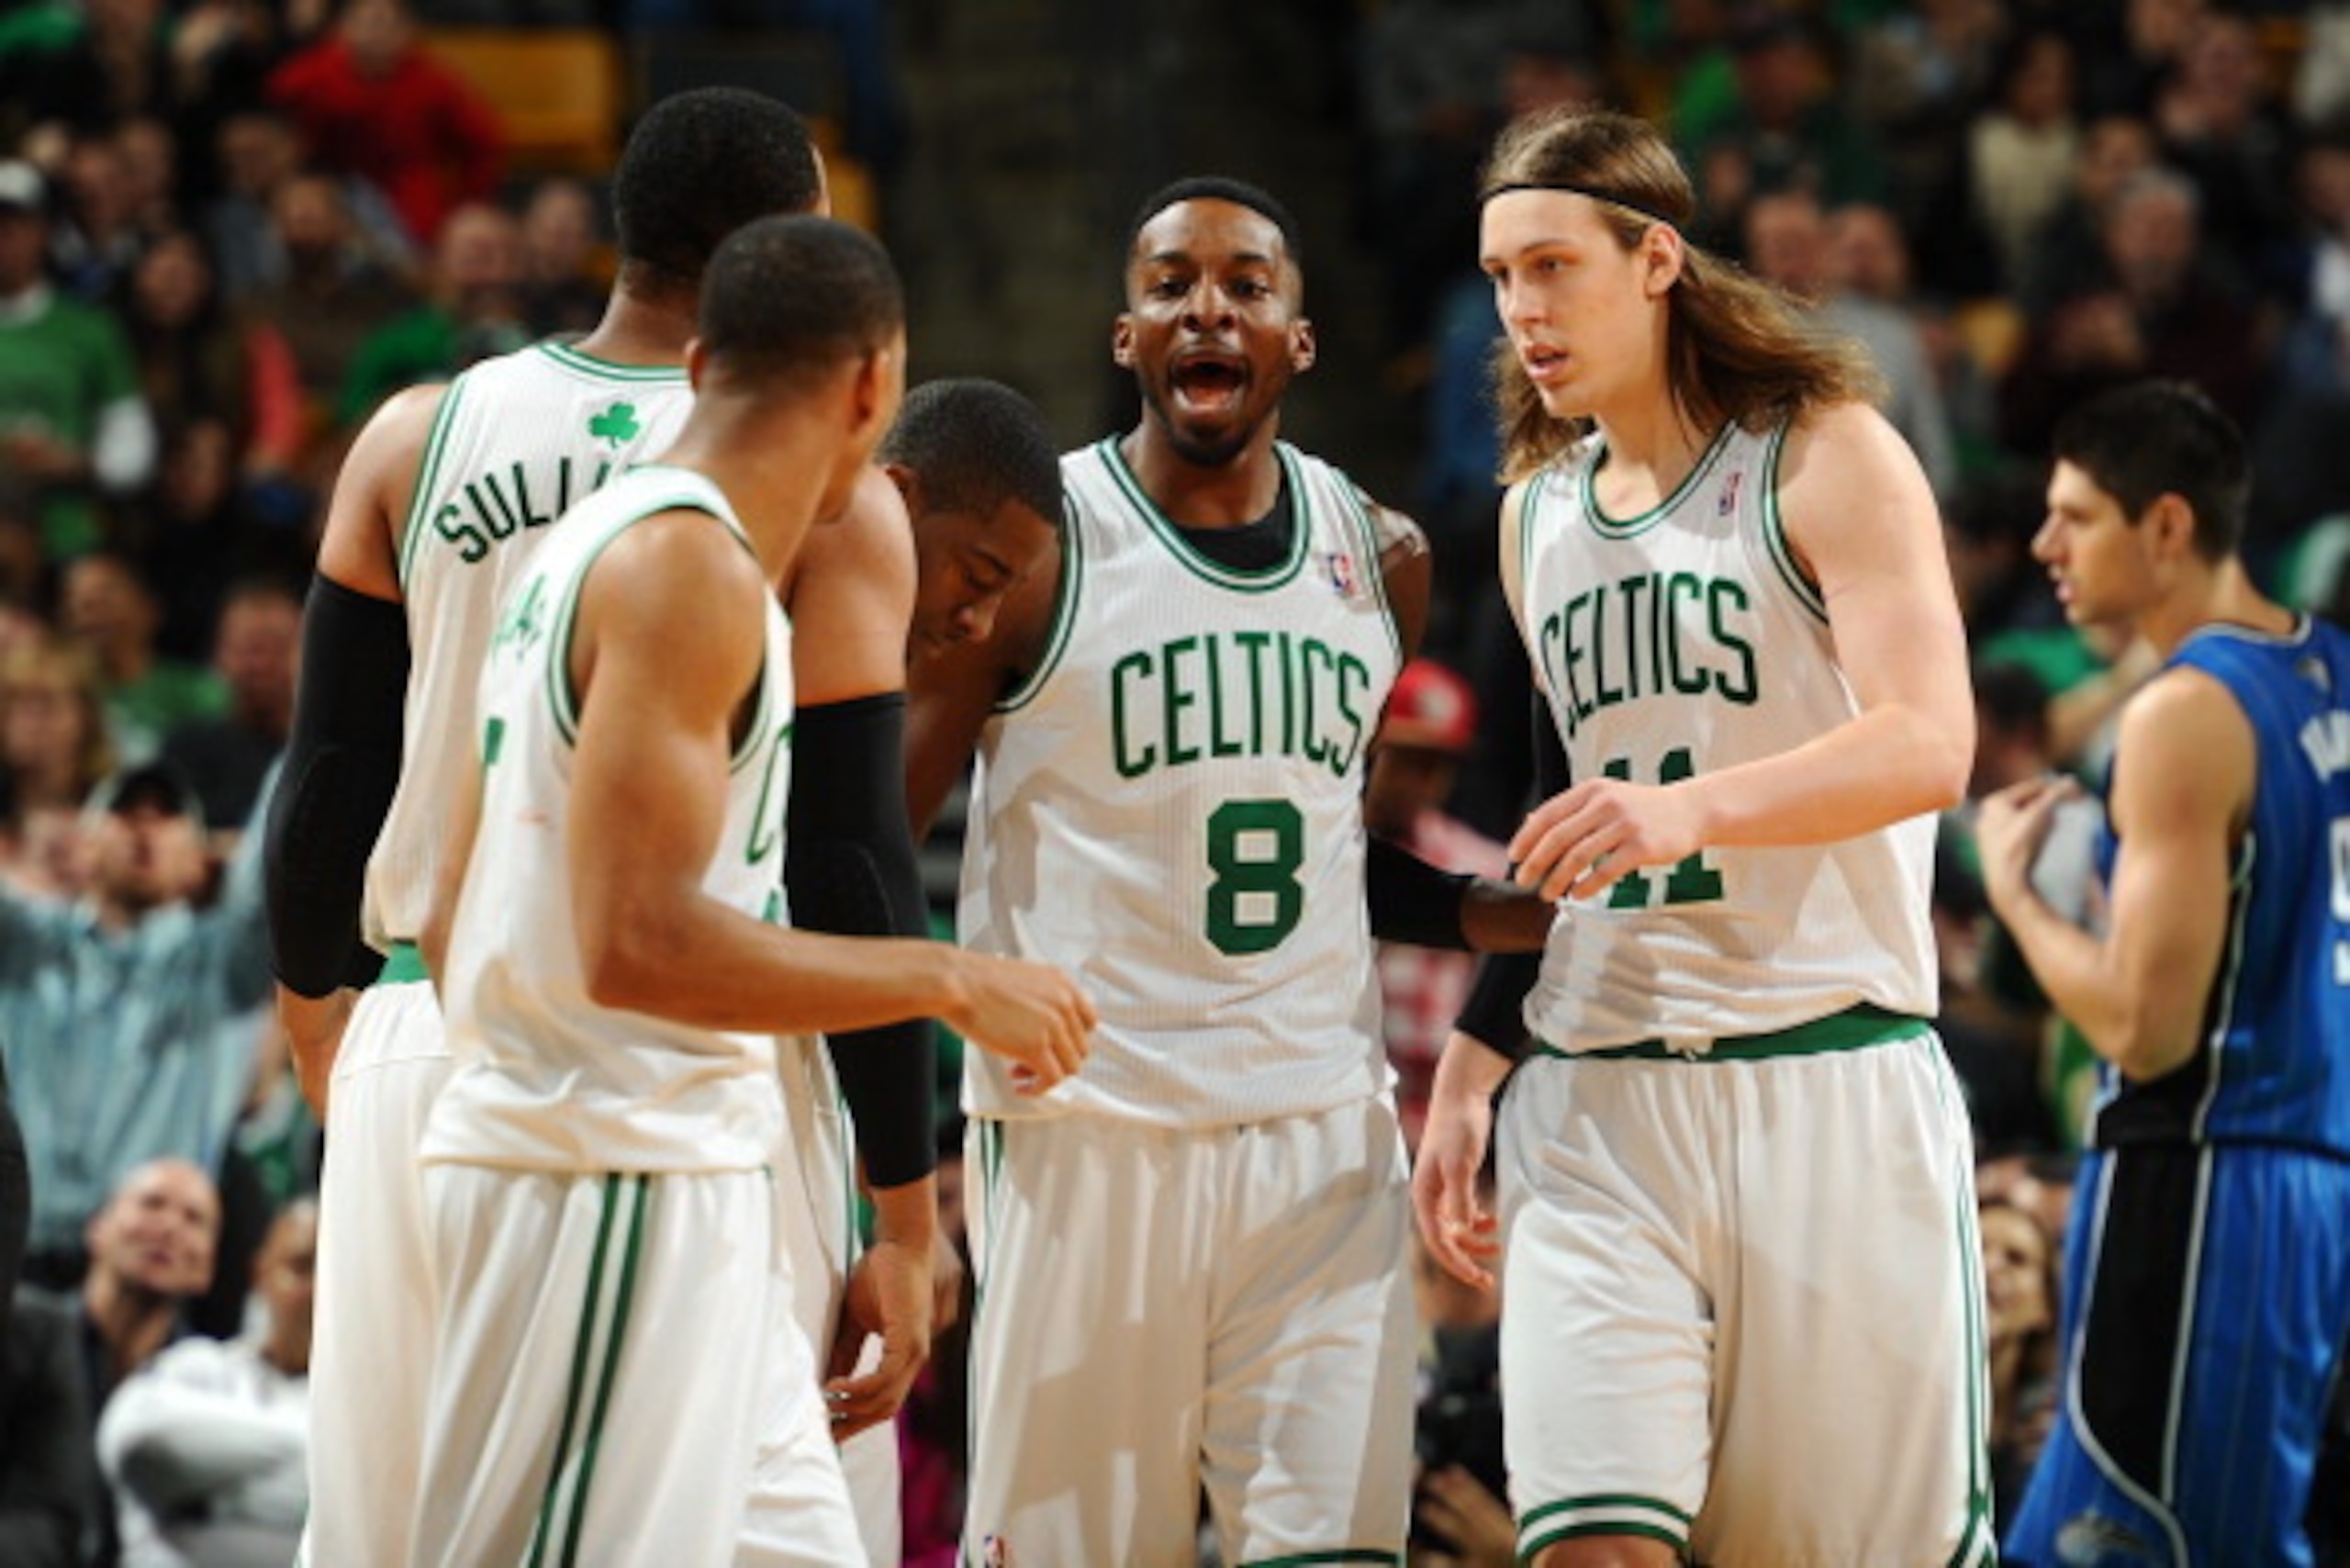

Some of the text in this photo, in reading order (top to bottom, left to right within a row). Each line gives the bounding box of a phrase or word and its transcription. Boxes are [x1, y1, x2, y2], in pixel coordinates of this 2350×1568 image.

[1112, 631, 1371, 778] CELTICS
[1541, 571, 1758, 738] CELTICS
[1205, 799, 1304, 956] 8
